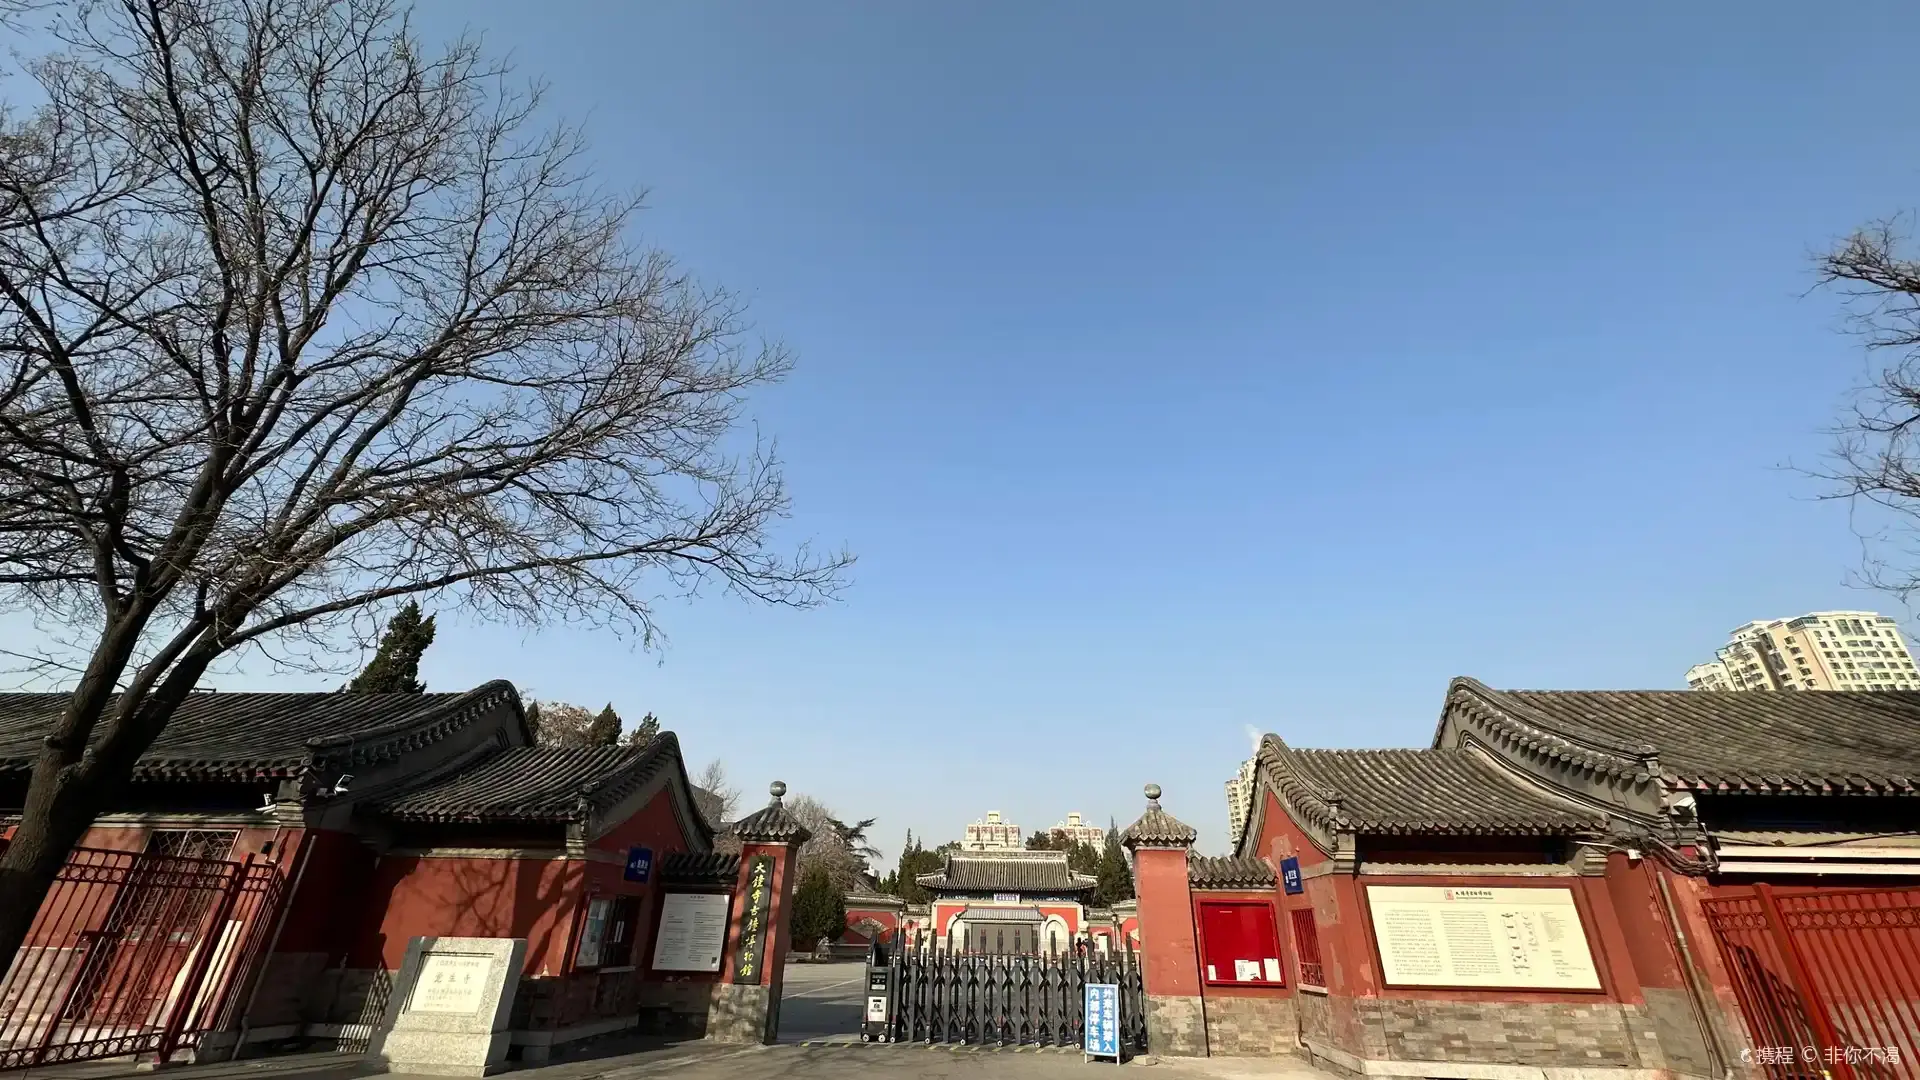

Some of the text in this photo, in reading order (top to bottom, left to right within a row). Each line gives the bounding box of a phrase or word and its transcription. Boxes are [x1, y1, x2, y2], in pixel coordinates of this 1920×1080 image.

[1089, 987, 1100, 1052] 内部停车场
[1103, 988, 1114, 1053] 外来车辆禁入
